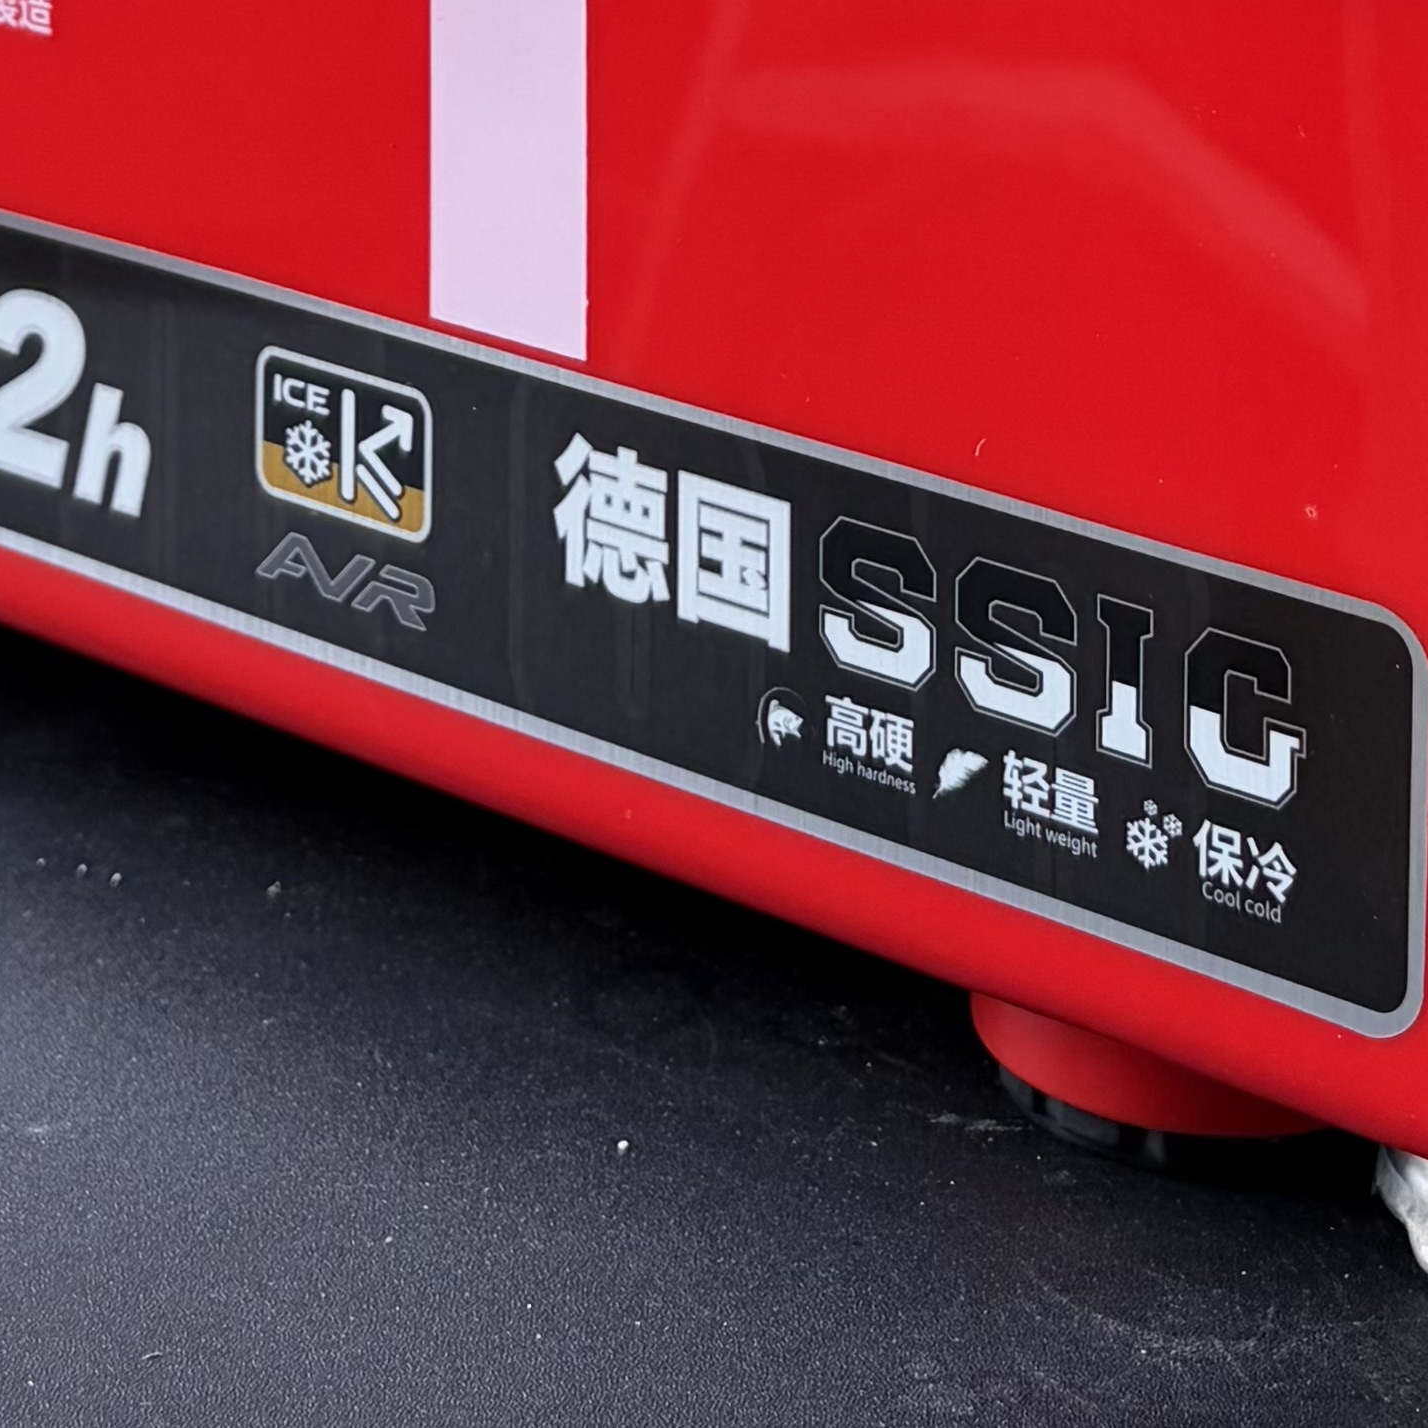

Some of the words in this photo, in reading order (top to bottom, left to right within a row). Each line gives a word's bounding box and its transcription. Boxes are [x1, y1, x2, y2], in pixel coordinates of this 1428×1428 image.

[273, 373, 330, 416] ICE
[824, 694, 915, 774] 高硬
[822, 750, 855, 776] High
[856, 758, 917, 795] hardness
[1002, 749, 1099, 835] 轻量
[1003, 810, 1042, 843] Light
[1044, 826, 1098, 858] weight
[1192, 818, 1298, 904] 保冷
[1201, 881, 1241, 912] Cool
[1244, 890, 1283, 924] cold
